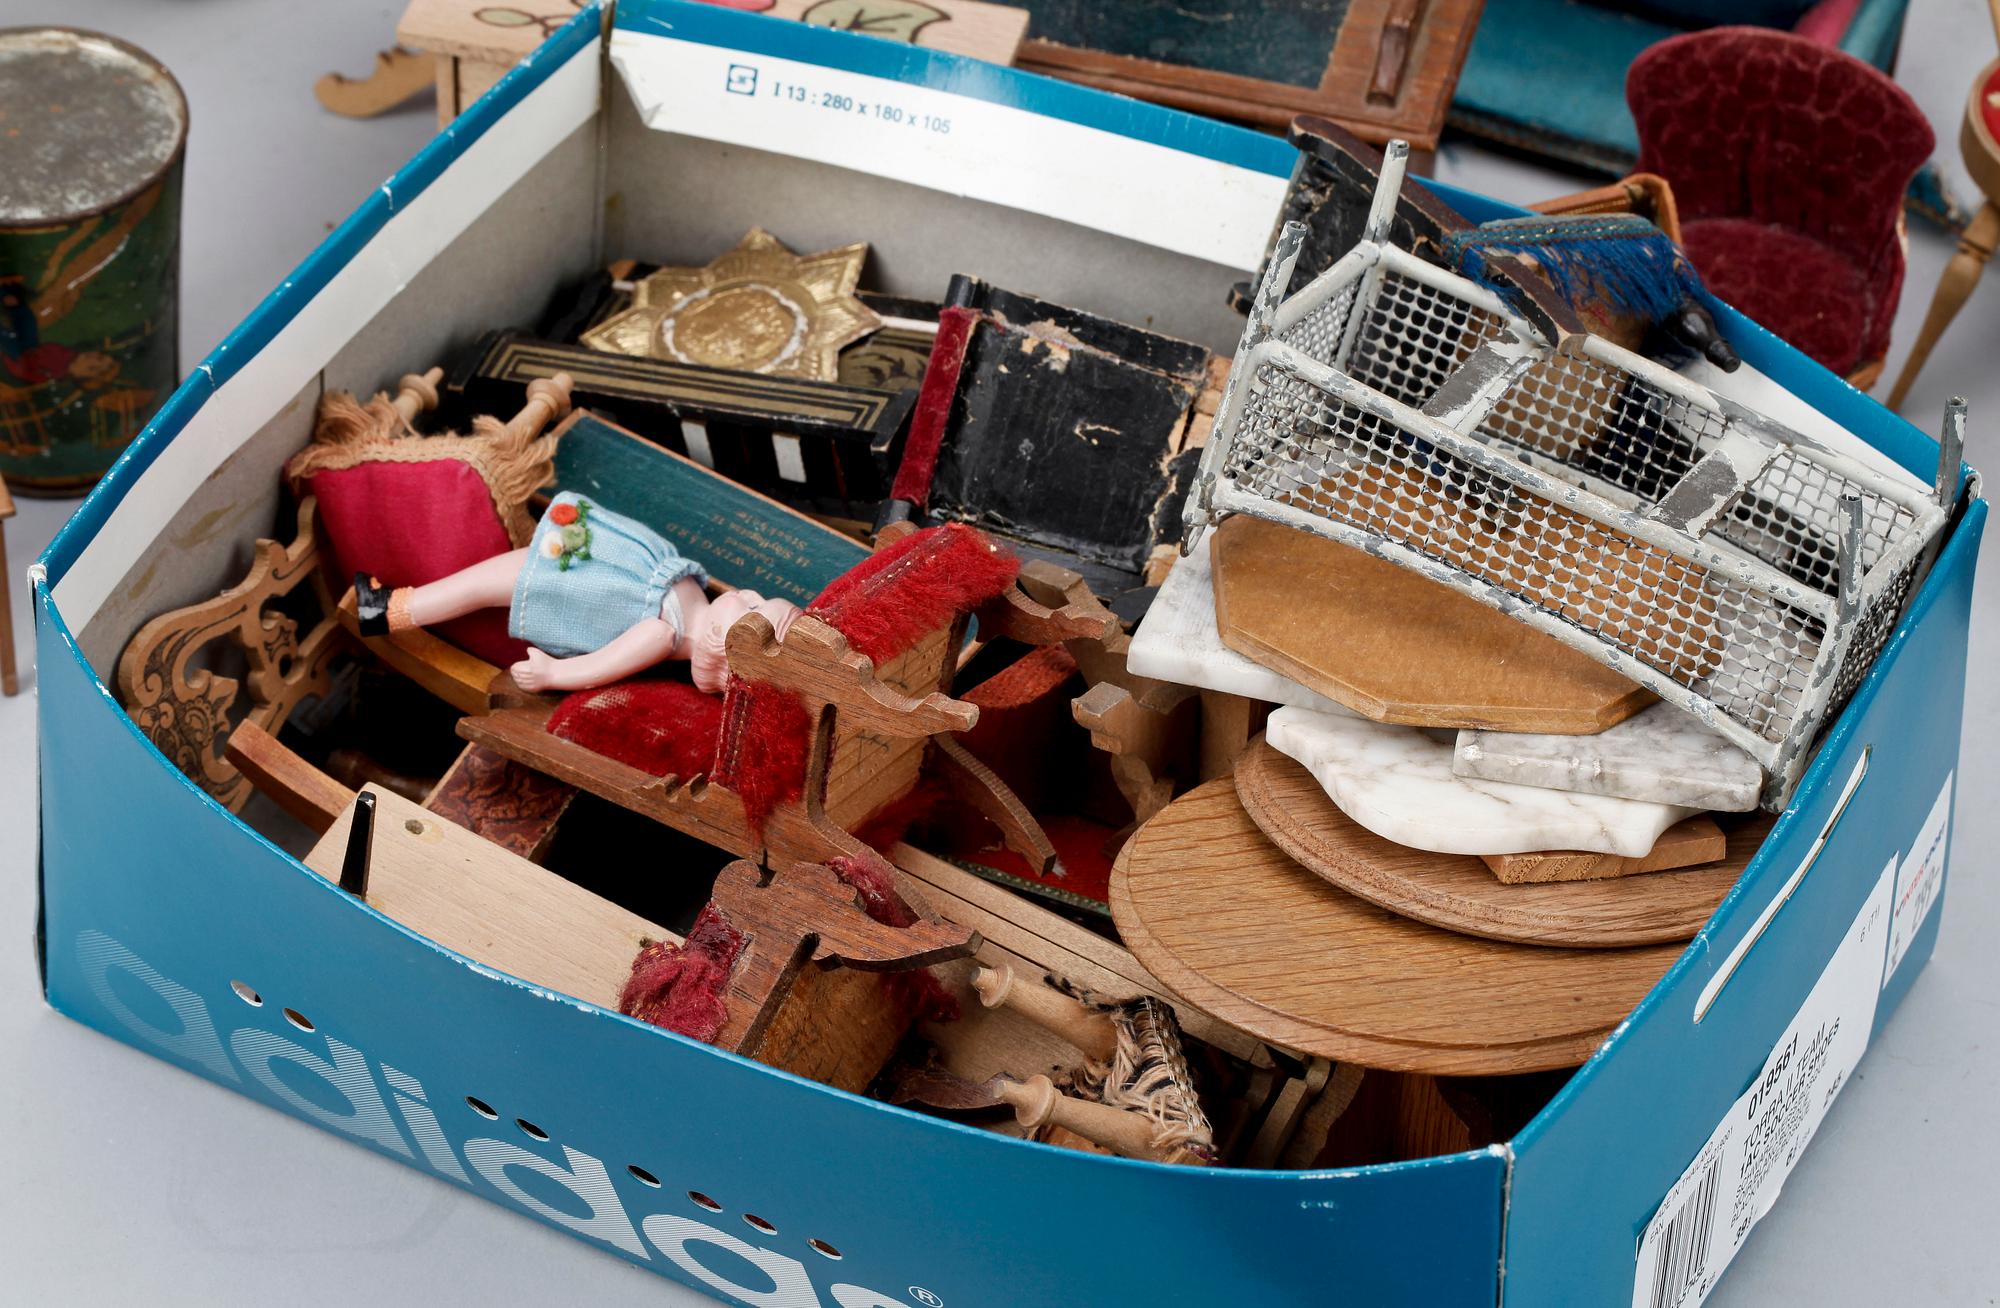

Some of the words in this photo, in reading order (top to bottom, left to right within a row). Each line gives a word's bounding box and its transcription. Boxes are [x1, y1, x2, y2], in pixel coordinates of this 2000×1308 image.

[787, 86, 806, 102] 13
[822, 93, 852, 112] 280
[858, 103, 867, 115] x
[874, 104, 903, 122] 180
[907, 114, 916, 126] x
[923, 115, 951, 134] 105
[75, 928, 917, 1308] adida
[1744, 1090, 1782, 1156] TORRA
[1797, 1022, 1825, 1079] TEAM
[1748, 1031, 1798, 1120] 019561
[1763, 1072, 1806, 1145] SOCCER
[1808, 1017, 1839, 1077] SHOES
